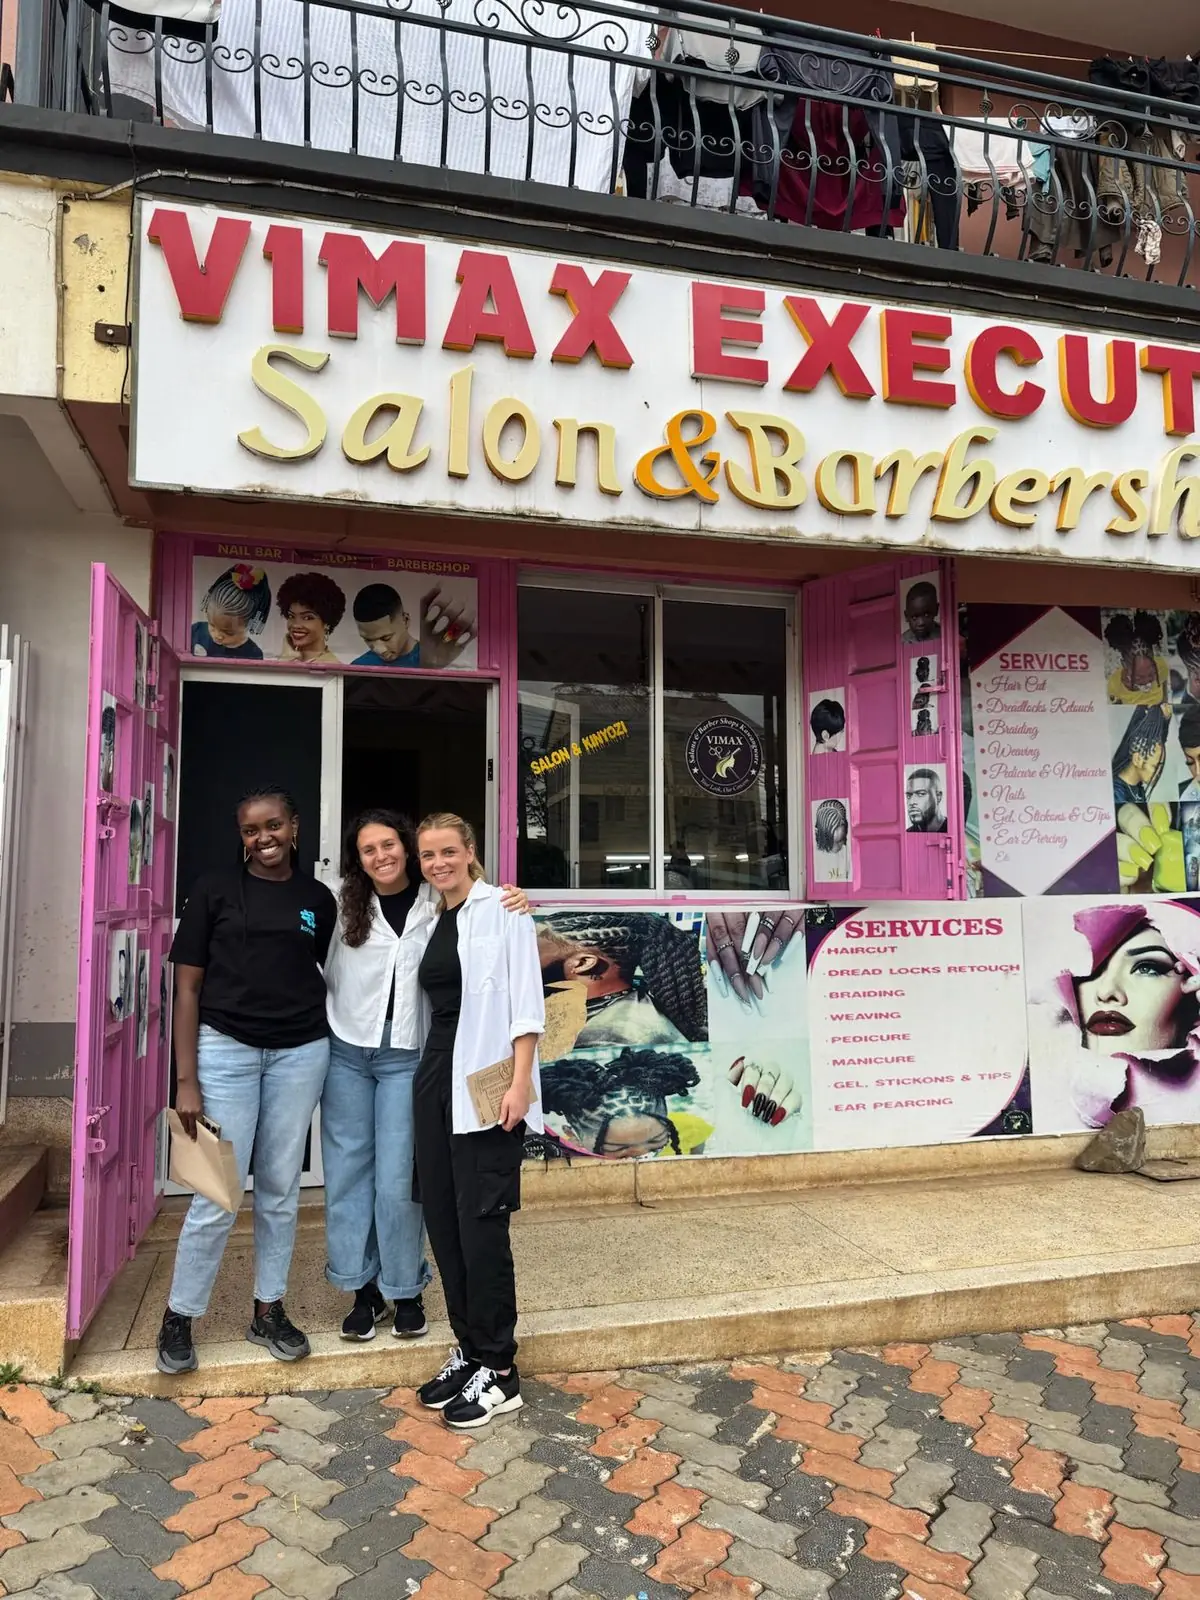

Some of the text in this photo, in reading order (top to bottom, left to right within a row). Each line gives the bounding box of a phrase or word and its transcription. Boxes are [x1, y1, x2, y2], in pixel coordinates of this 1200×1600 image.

[690, 281, 1200, 436] EXECUT
[237, 344, 622, 495] Salon
[634, 410, 720, 503] &
[217, 544, 282, 559] NAIL BAR
[388, 558, 471, 573] BARBERSHOP
[1000, 653, 1089, 671] SERVICES
[984, 676, 1047, 693] Hair Cut
[986, 698, 1094, 713] Dreadlocks Retouch
[720, 717, 739, 727] Shops
[987, 719, 1039, 740] Braiding
[530, 720, 628, 775] SALON & KINYOZI
[706, 735, 743, 745] VIMAX
[988, 741, 1041, 762] Weaving
[989, 762, 1107, 779] Pedicure & Manicure
[990, 785, 1026, 803] Nails
[1018, 805, 1066, 824] Stickons
[1069, 807, 1080, 822] &
[1082, 806, 1111, 824] Tips
[994, 828, 1068, 849] Ear Piercing
[845, 918, 1004, 938] SERVICES
[827, 946, 898, 955] HAIRCUT
[828, 964, 1020, 977] DREAD LOCKS RETOUCH
[829, 989, 905, 999] BRAIDING
[830, 1011, 902, 1021] WEAVING
[831, 1033, 911, 1044] PEDICURE
[832, 1055, 916, 1066] MANICURE
[833, 1072, 1012, 1089] GEL. STICKONS & TIPS
[834, 1097, 953, 1112] EAR PEARCING
